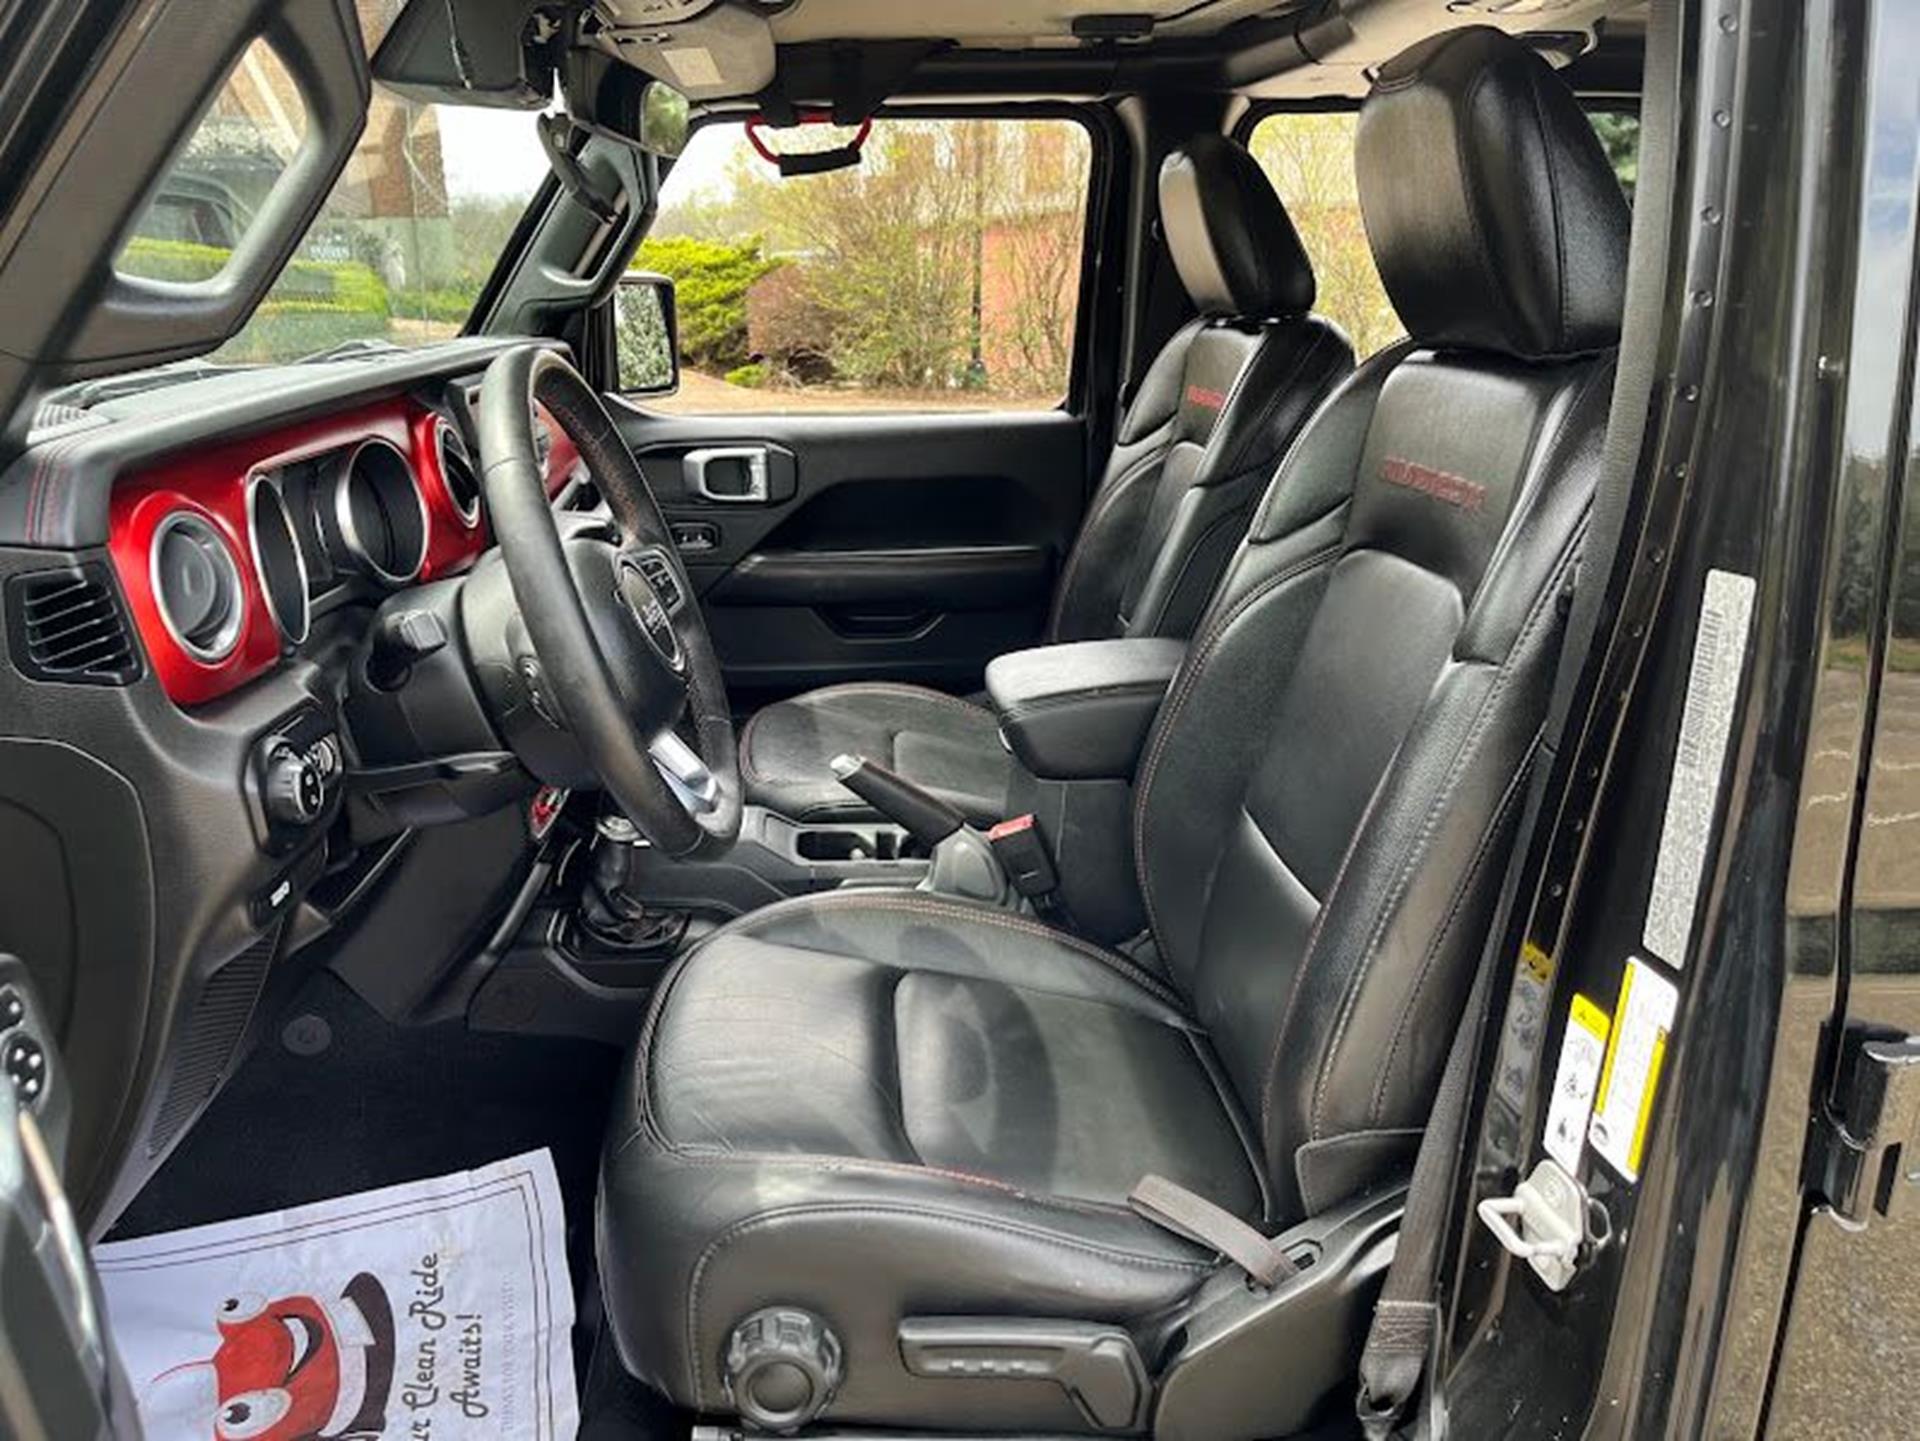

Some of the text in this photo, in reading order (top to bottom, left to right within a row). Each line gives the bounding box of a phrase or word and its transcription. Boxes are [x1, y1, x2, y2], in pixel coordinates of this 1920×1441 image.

[408, 1252, 446, 1331] Ride
[402, 1338, 439, 1412] Clean
[450, 1314, 489, 1418] Awaits!
